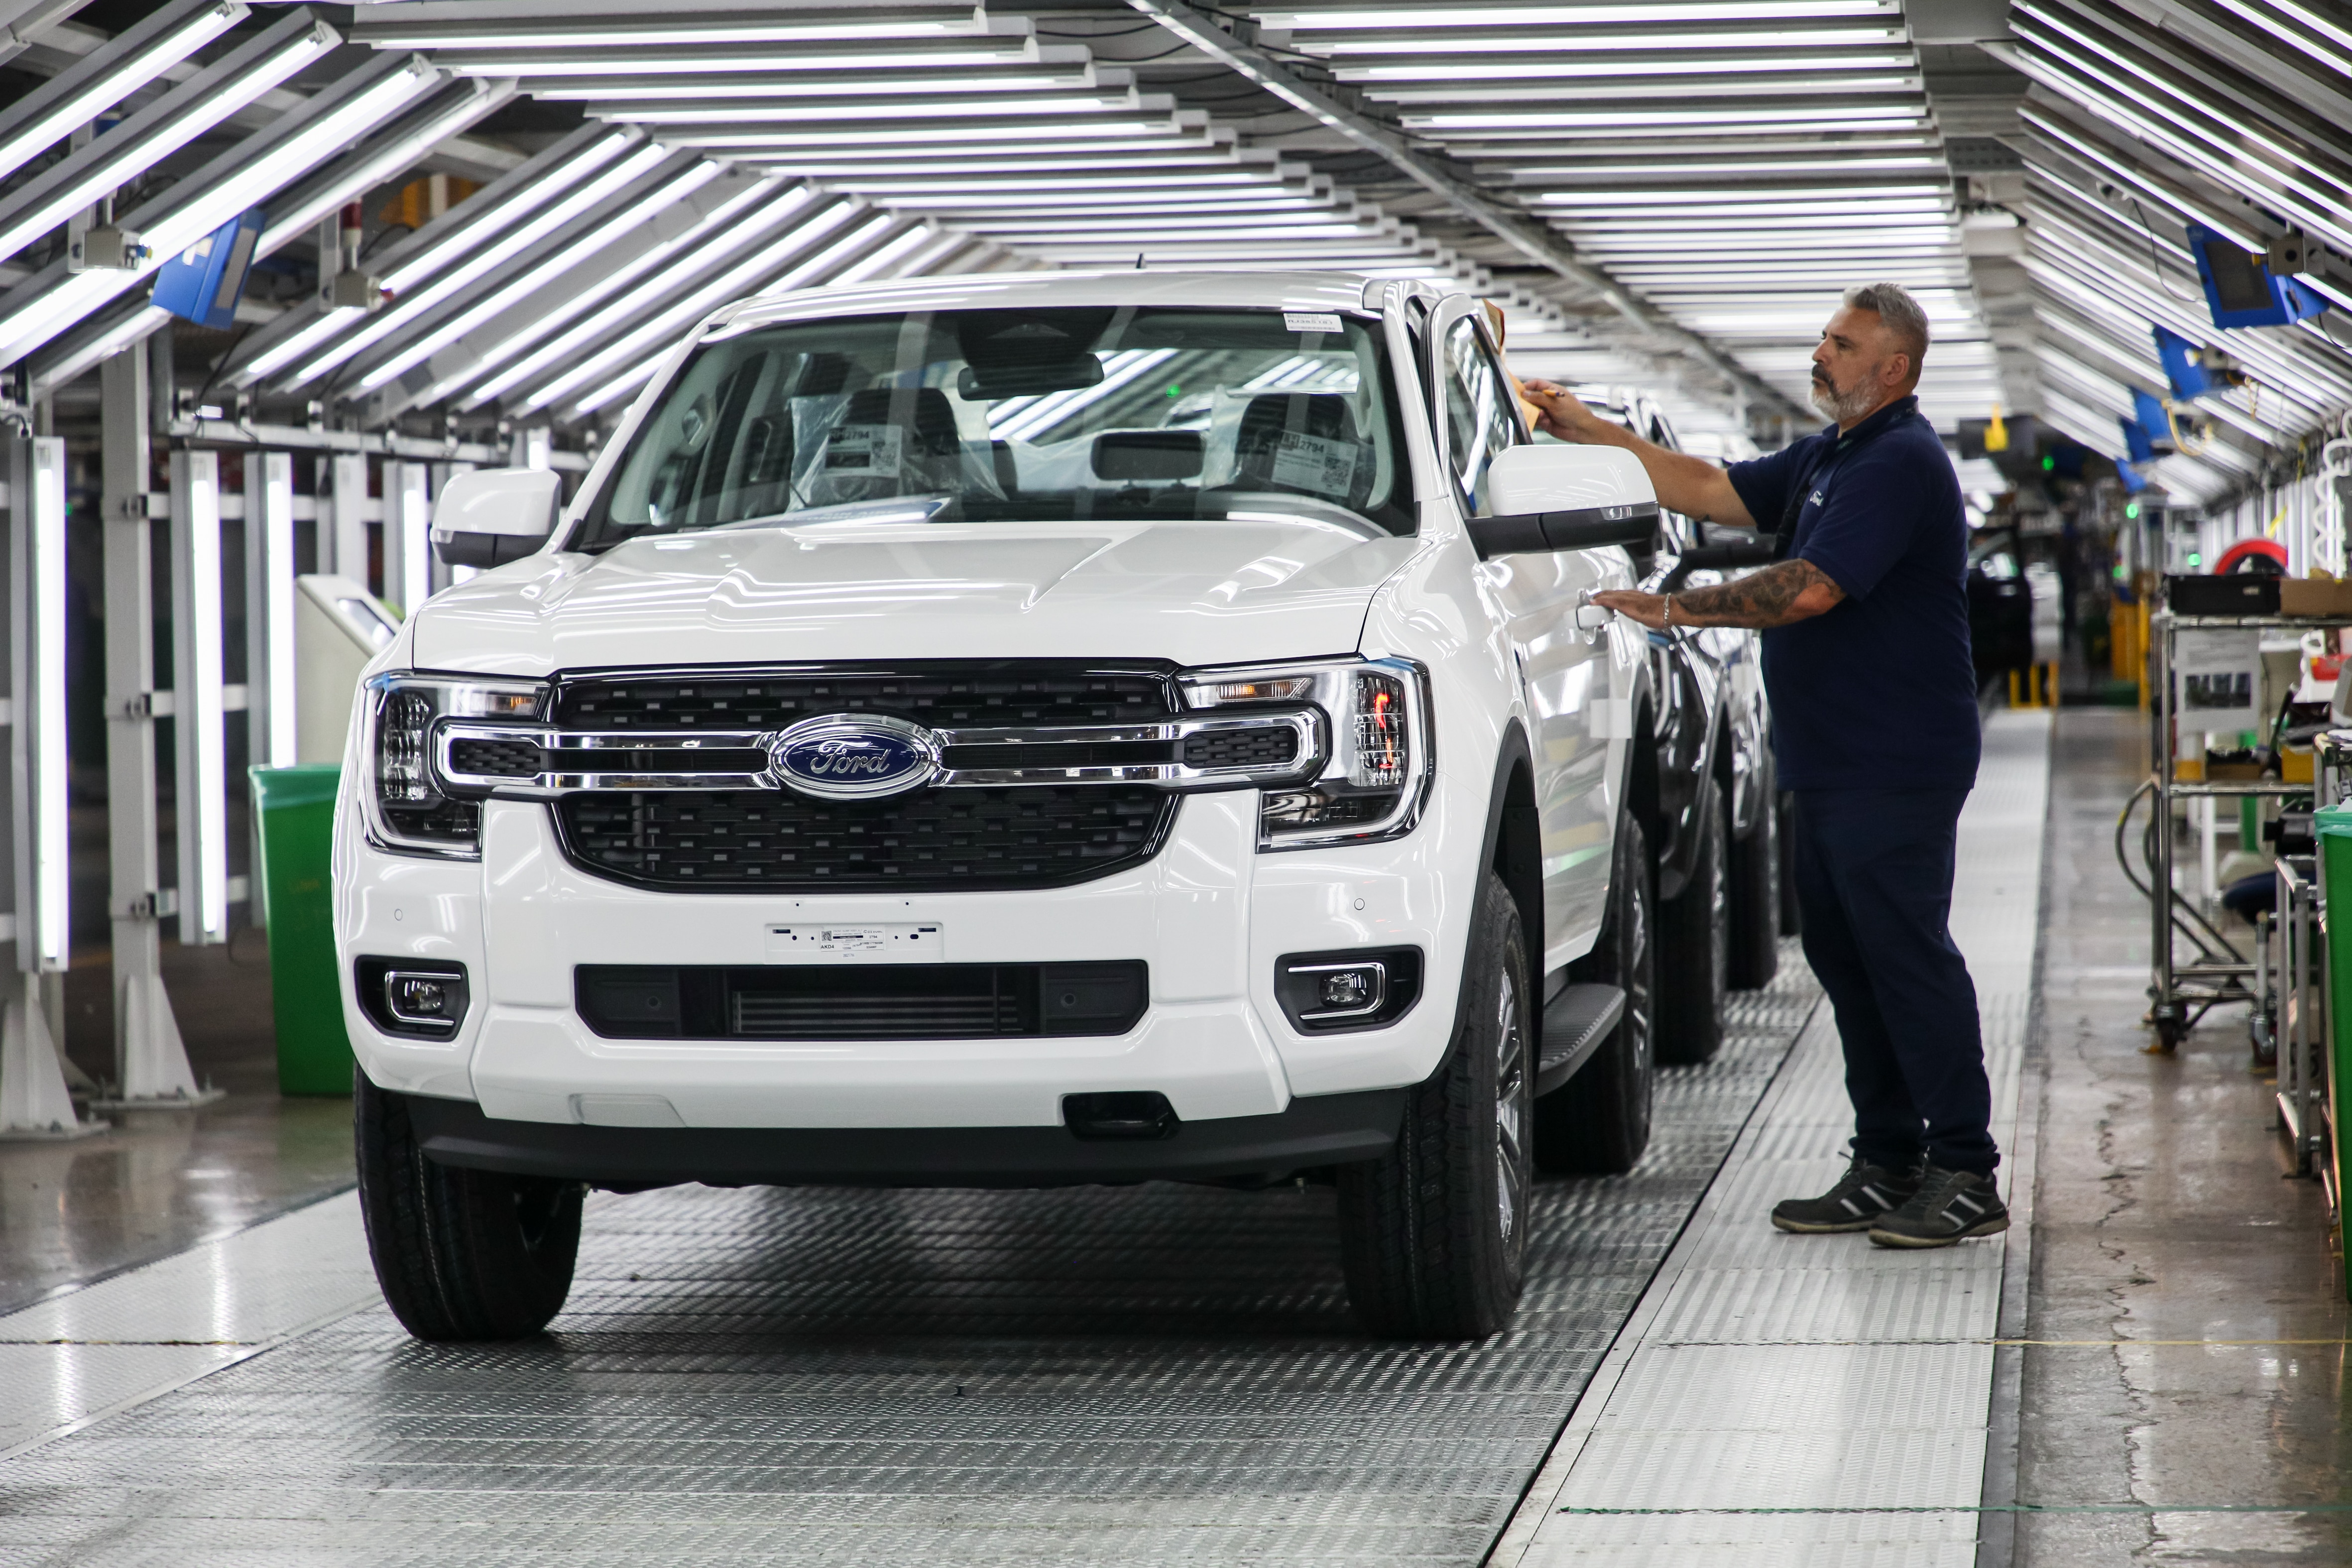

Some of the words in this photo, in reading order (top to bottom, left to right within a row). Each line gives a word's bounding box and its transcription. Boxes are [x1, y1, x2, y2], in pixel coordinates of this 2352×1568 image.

[845, 431, 870, 439] 2794
[1299, 441, 1324, 453] 2794
[810, 740, 892, 774] Ford
